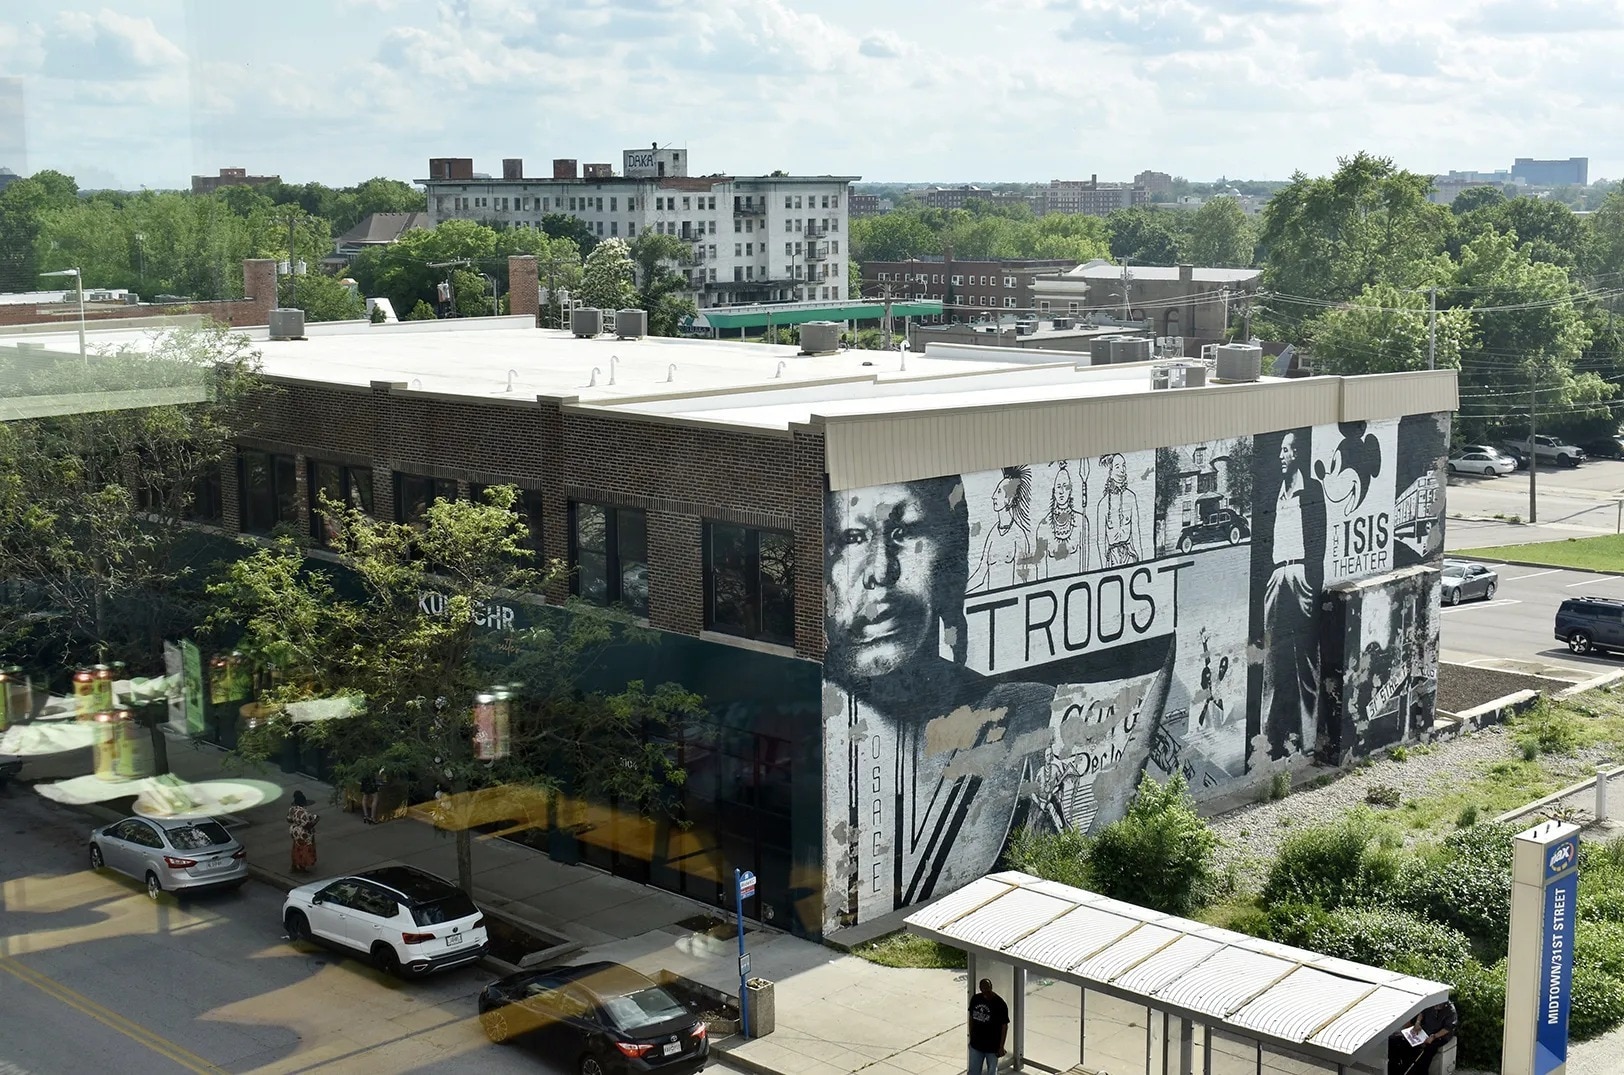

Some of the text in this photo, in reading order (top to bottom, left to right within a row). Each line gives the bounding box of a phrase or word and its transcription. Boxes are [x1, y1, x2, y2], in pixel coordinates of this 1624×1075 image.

[1332, 550, 1388, 578] THEATER
[1343, 512, 1389, 558] ISIS
[966, 560, 1195, 671] TROOST
[872, 734, 882, 893] OSAGE
[1547, 887, 1566, 1025] MIDTOWN/31ST STREET
